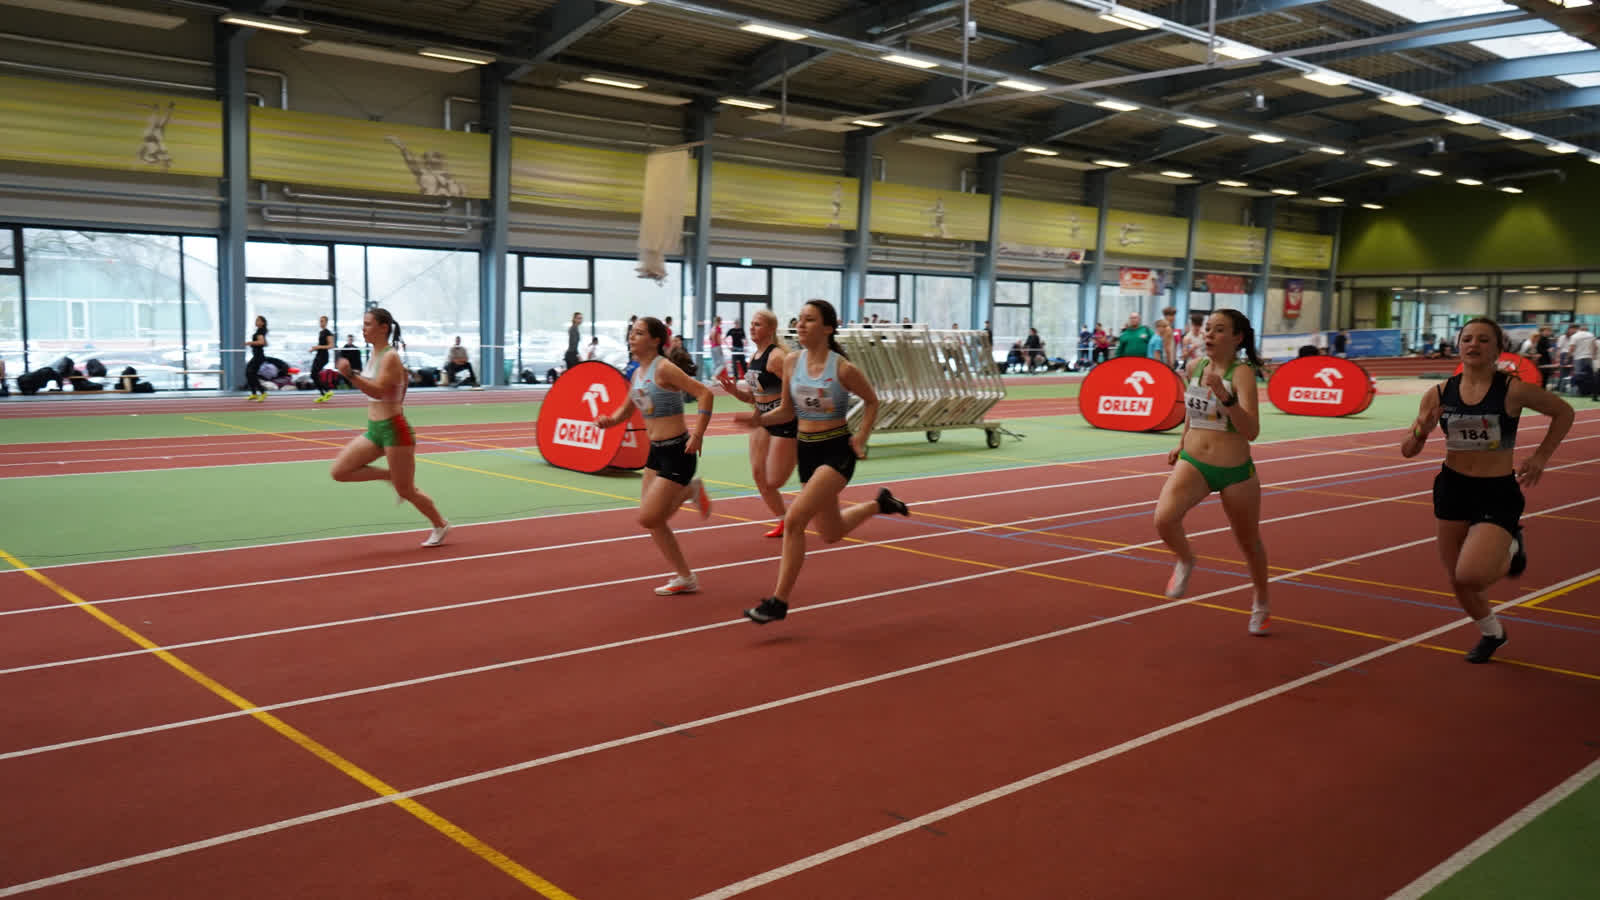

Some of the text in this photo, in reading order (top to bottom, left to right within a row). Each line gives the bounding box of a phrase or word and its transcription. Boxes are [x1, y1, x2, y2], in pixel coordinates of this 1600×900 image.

[1293, 390, 1338, 401] ORLEN
[756, 398, 781, 412] NIKE
[1102, 399, 1148, 412] ORLEN
[1188, 397, 1209, 412] 437
[558, 422, 600, 445] ORLEN
[1459, 429, 1489, 440] 184
